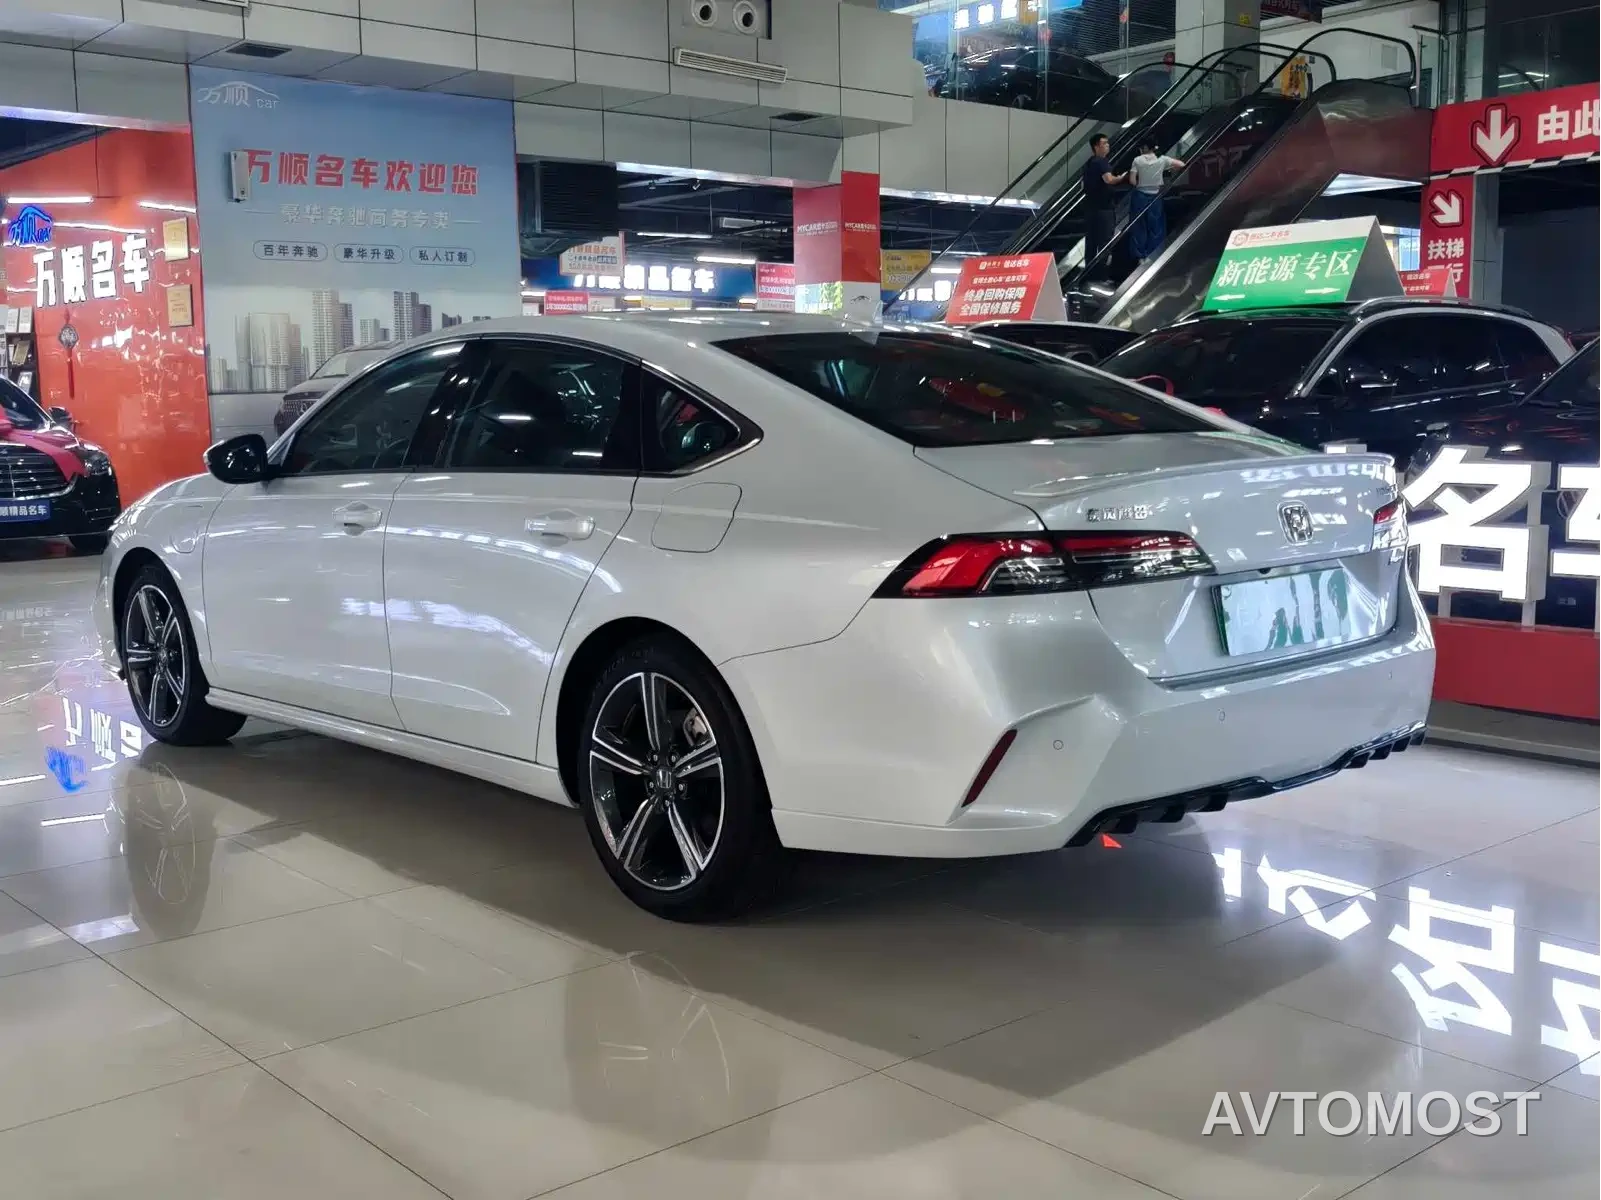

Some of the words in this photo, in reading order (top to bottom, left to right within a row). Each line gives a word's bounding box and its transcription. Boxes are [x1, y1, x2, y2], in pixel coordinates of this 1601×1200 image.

[242, 148, 478, 196] 万顺名车欢迎您
[263, 244, 320, 258] 百年奔驰
[343, 246, 395, 261] 豪华升级
[418, 249, 469, 264] 私人订制
[1428, 238, 1464, 260] 扶梯
[33, 235, 150, 308] 万顺名车
[1217, 248, 1358, 287] 新能源专区
[1428, 263, 1464, 283] 行
[963, 286, 1027, 302] 终身回购保障
[959, 301, 1022, 316] 全国保修服务
